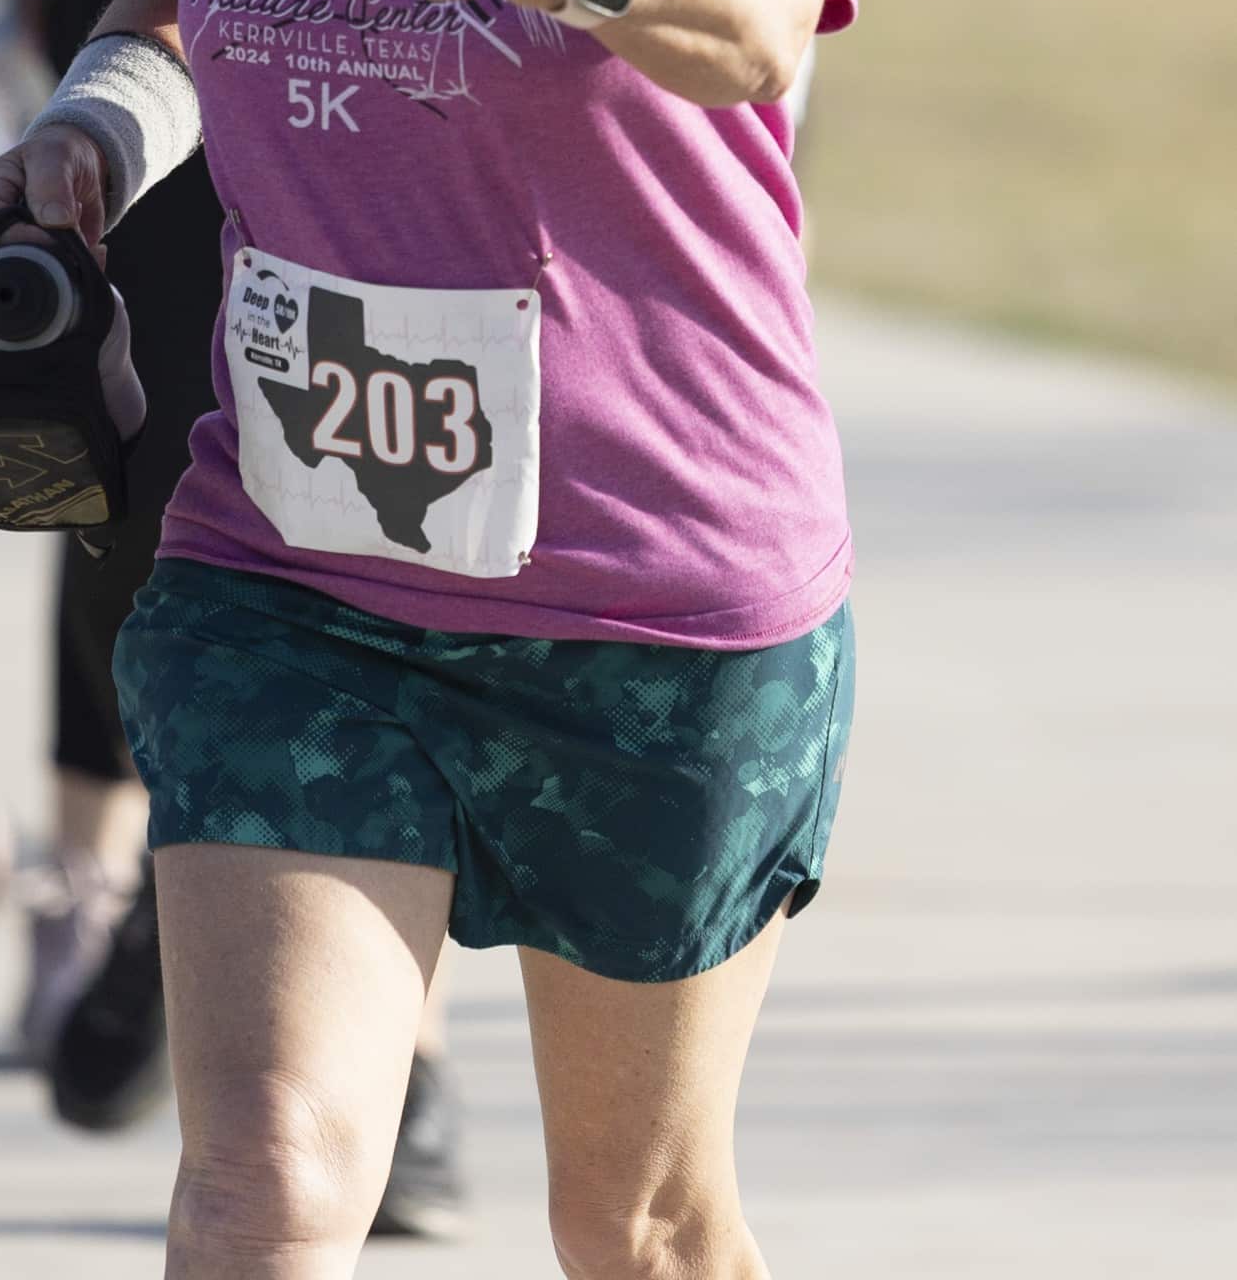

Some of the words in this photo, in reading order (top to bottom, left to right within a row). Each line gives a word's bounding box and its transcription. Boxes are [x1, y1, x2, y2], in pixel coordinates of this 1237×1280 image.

[218, 19, 355, 57] KERRVILLE,
[364, 37, 432, 62] TEXAS
[224, 45, 271, 66] 2024
[285, 53, 330, 73] 10th
[337, 60, 424, 81] ANNUAL
[288, 77, 361, 133] 5K
[243, 287, 270, 311] Deep
[251, 327, 281, 351] Heart
[311, 360, 479, 474] 203
